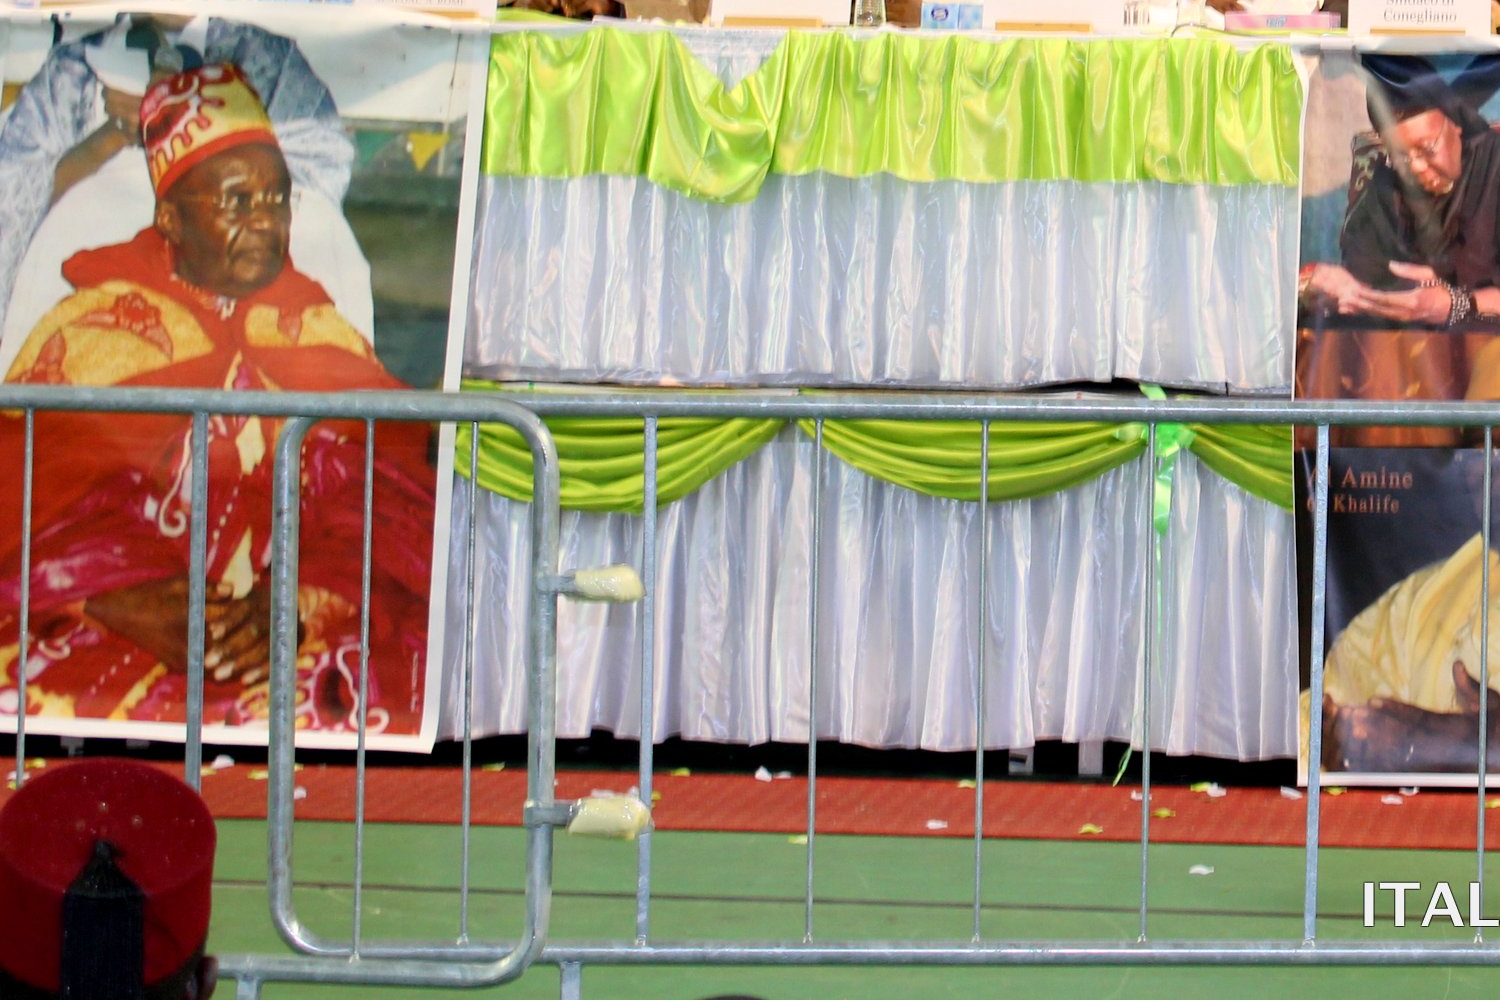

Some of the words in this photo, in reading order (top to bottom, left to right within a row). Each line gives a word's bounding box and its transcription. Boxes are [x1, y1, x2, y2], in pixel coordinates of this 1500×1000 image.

[1383, 9, 1457, 25] Conegliano
[1341, 465, 1413, 489] Amine
[1334, 494, 1400, 514] Khalife
